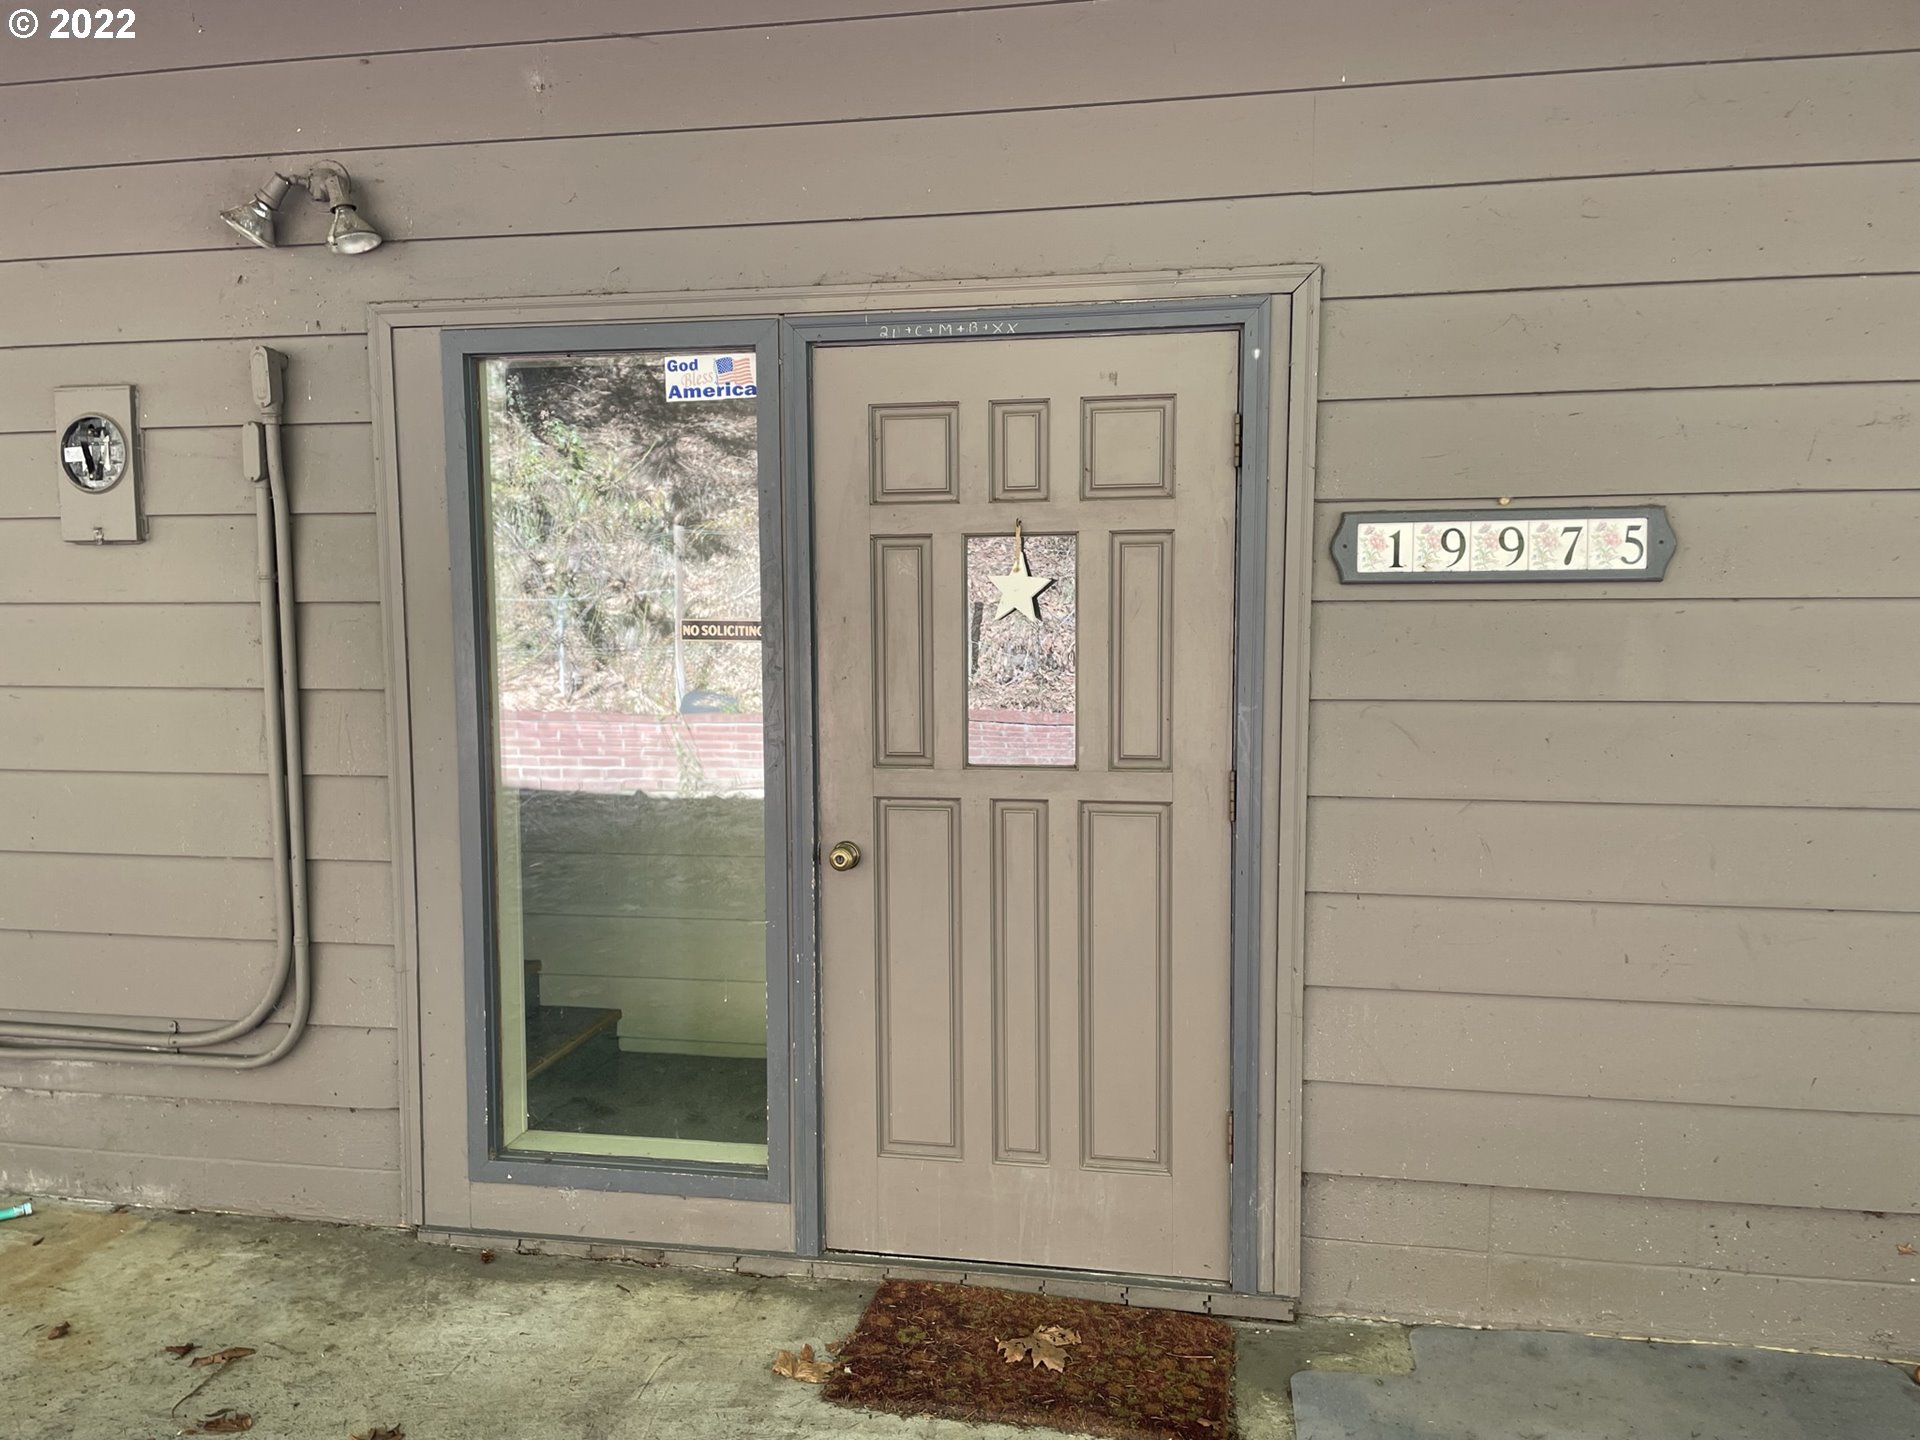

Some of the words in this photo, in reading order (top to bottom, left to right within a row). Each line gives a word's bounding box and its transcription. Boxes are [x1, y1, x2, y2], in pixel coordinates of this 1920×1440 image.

[667, 358, 699, 372] God
[681, 371, 714, 387] Bless
[668, 382, 758, 399] America
[1388, 525, 1645, 568] 19975
[682, 624, 700, 637] NO
